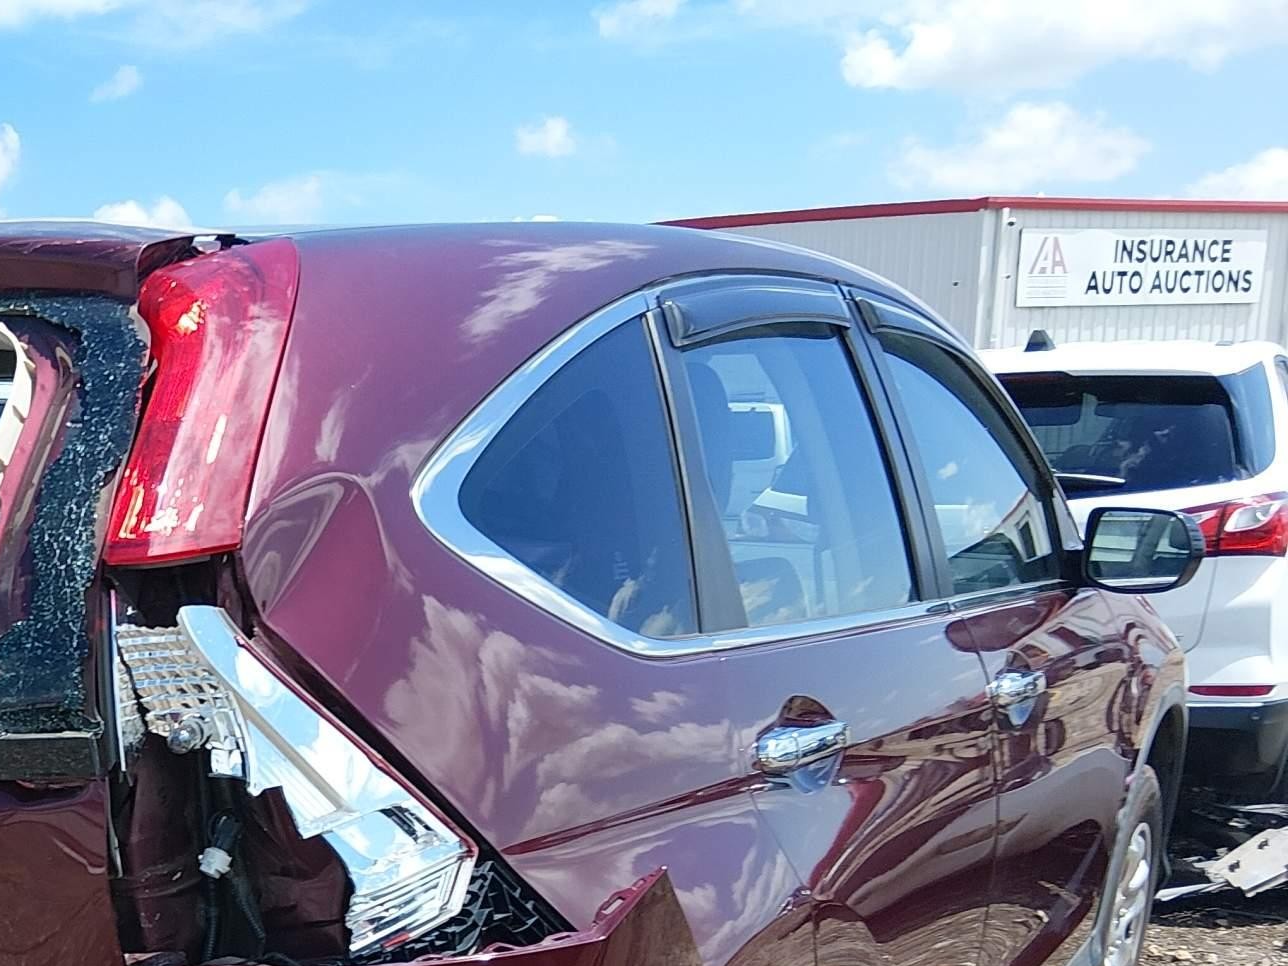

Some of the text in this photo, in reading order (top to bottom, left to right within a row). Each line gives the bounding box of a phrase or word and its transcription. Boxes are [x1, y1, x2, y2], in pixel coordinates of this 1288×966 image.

[1113, 239, 1233, 263] INSURANCE
[1084, 270, 1254, 295] AUTO AUCTIONS
